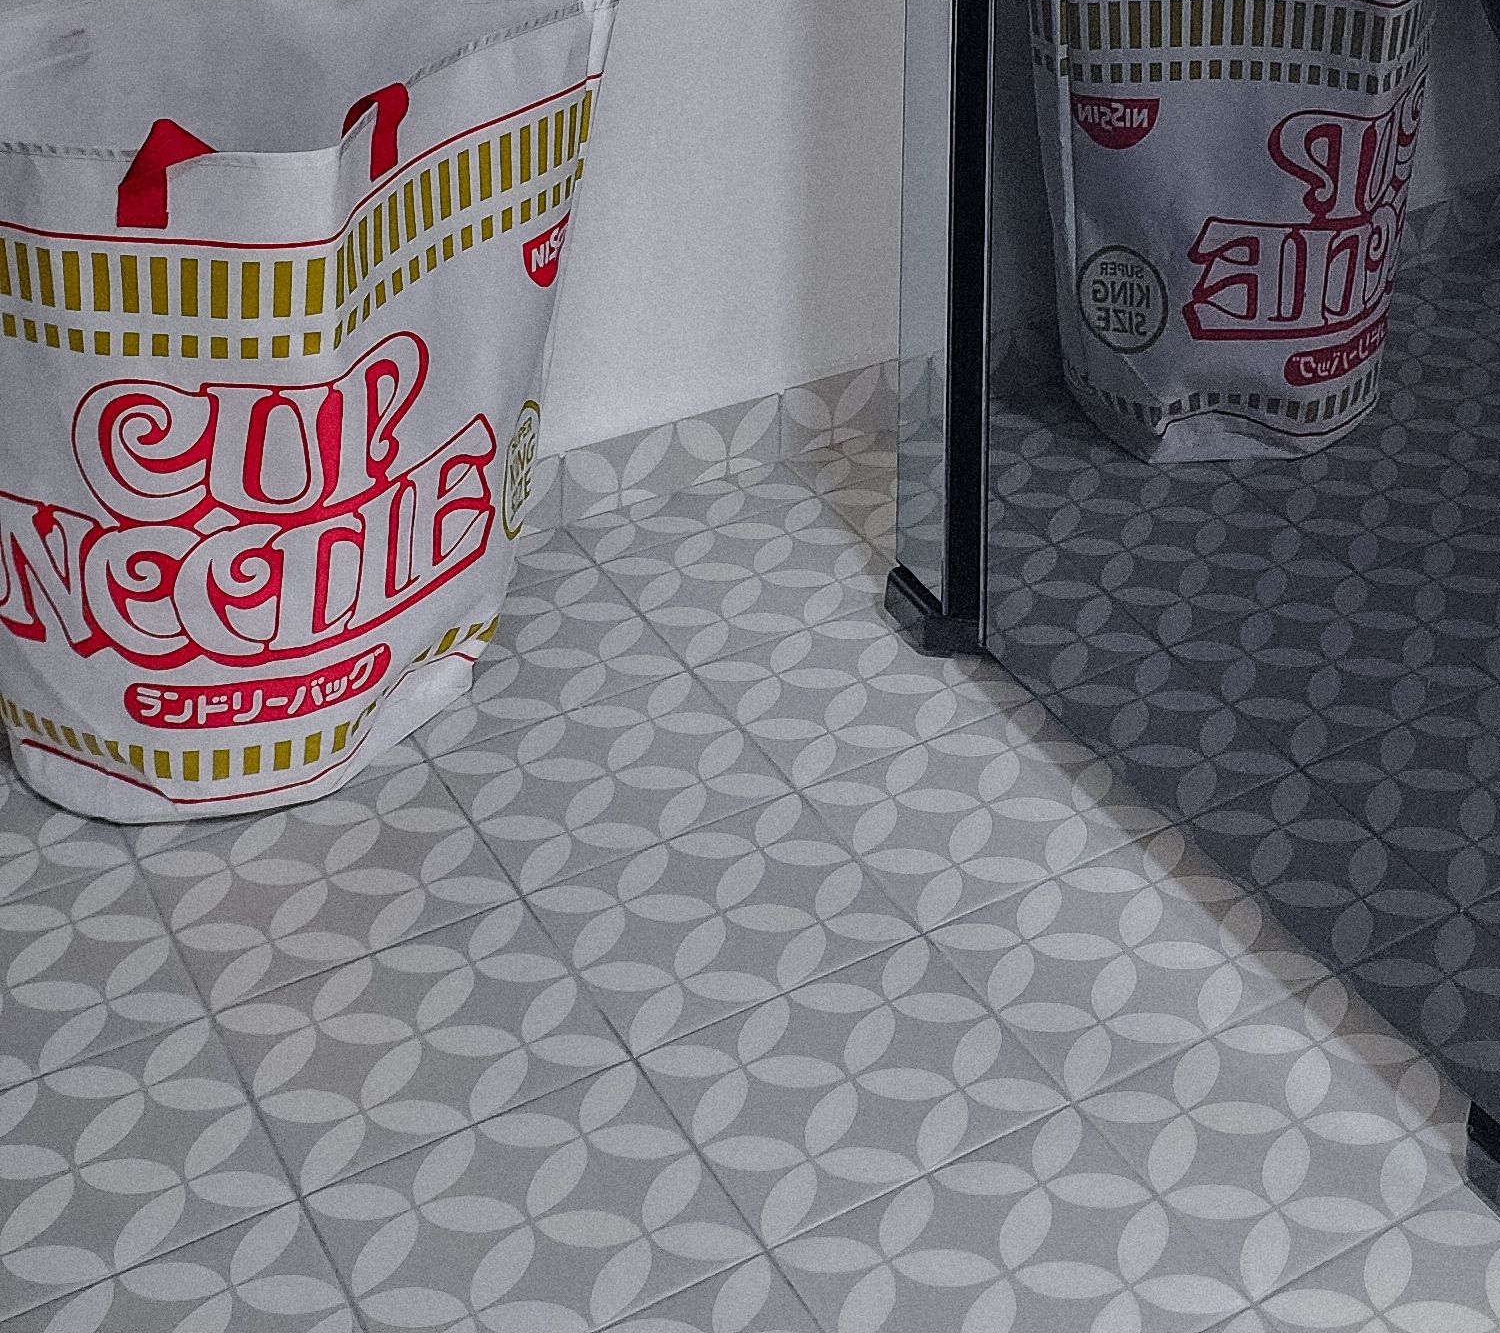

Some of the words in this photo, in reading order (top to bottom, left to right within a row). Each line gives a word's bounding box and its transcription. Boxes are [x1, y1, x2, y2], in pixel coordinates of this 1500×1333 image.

[72, 332, 428, 527] CUP
[0, 413, 497, 671] NOODLE
[135, 646, 385, 725] ランドリーバッグ
